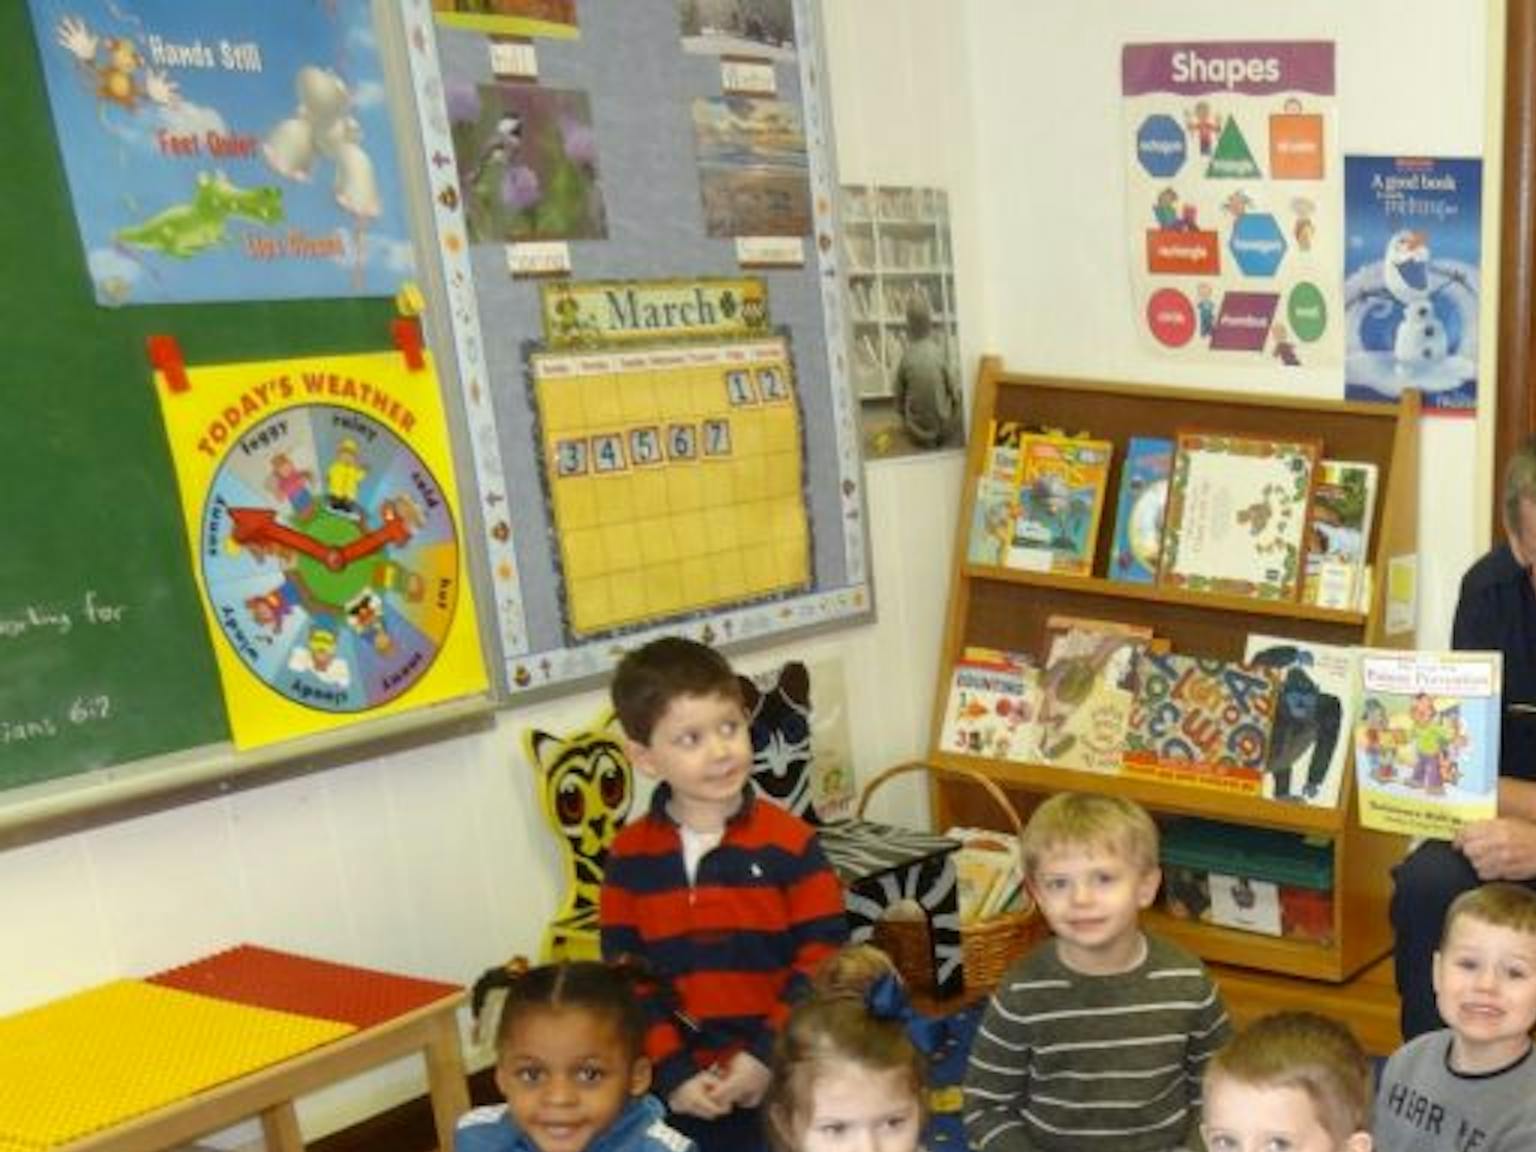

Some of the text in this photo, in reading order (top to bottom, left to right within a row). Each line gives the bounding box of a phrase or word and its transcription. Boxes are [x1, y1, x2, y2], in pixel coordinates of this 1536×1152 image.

[1171, 51, 1280, 87] Shapes
[605, 287, 716, 330] March
[197, 373, 417, 456] TODAY'S WEATHER
